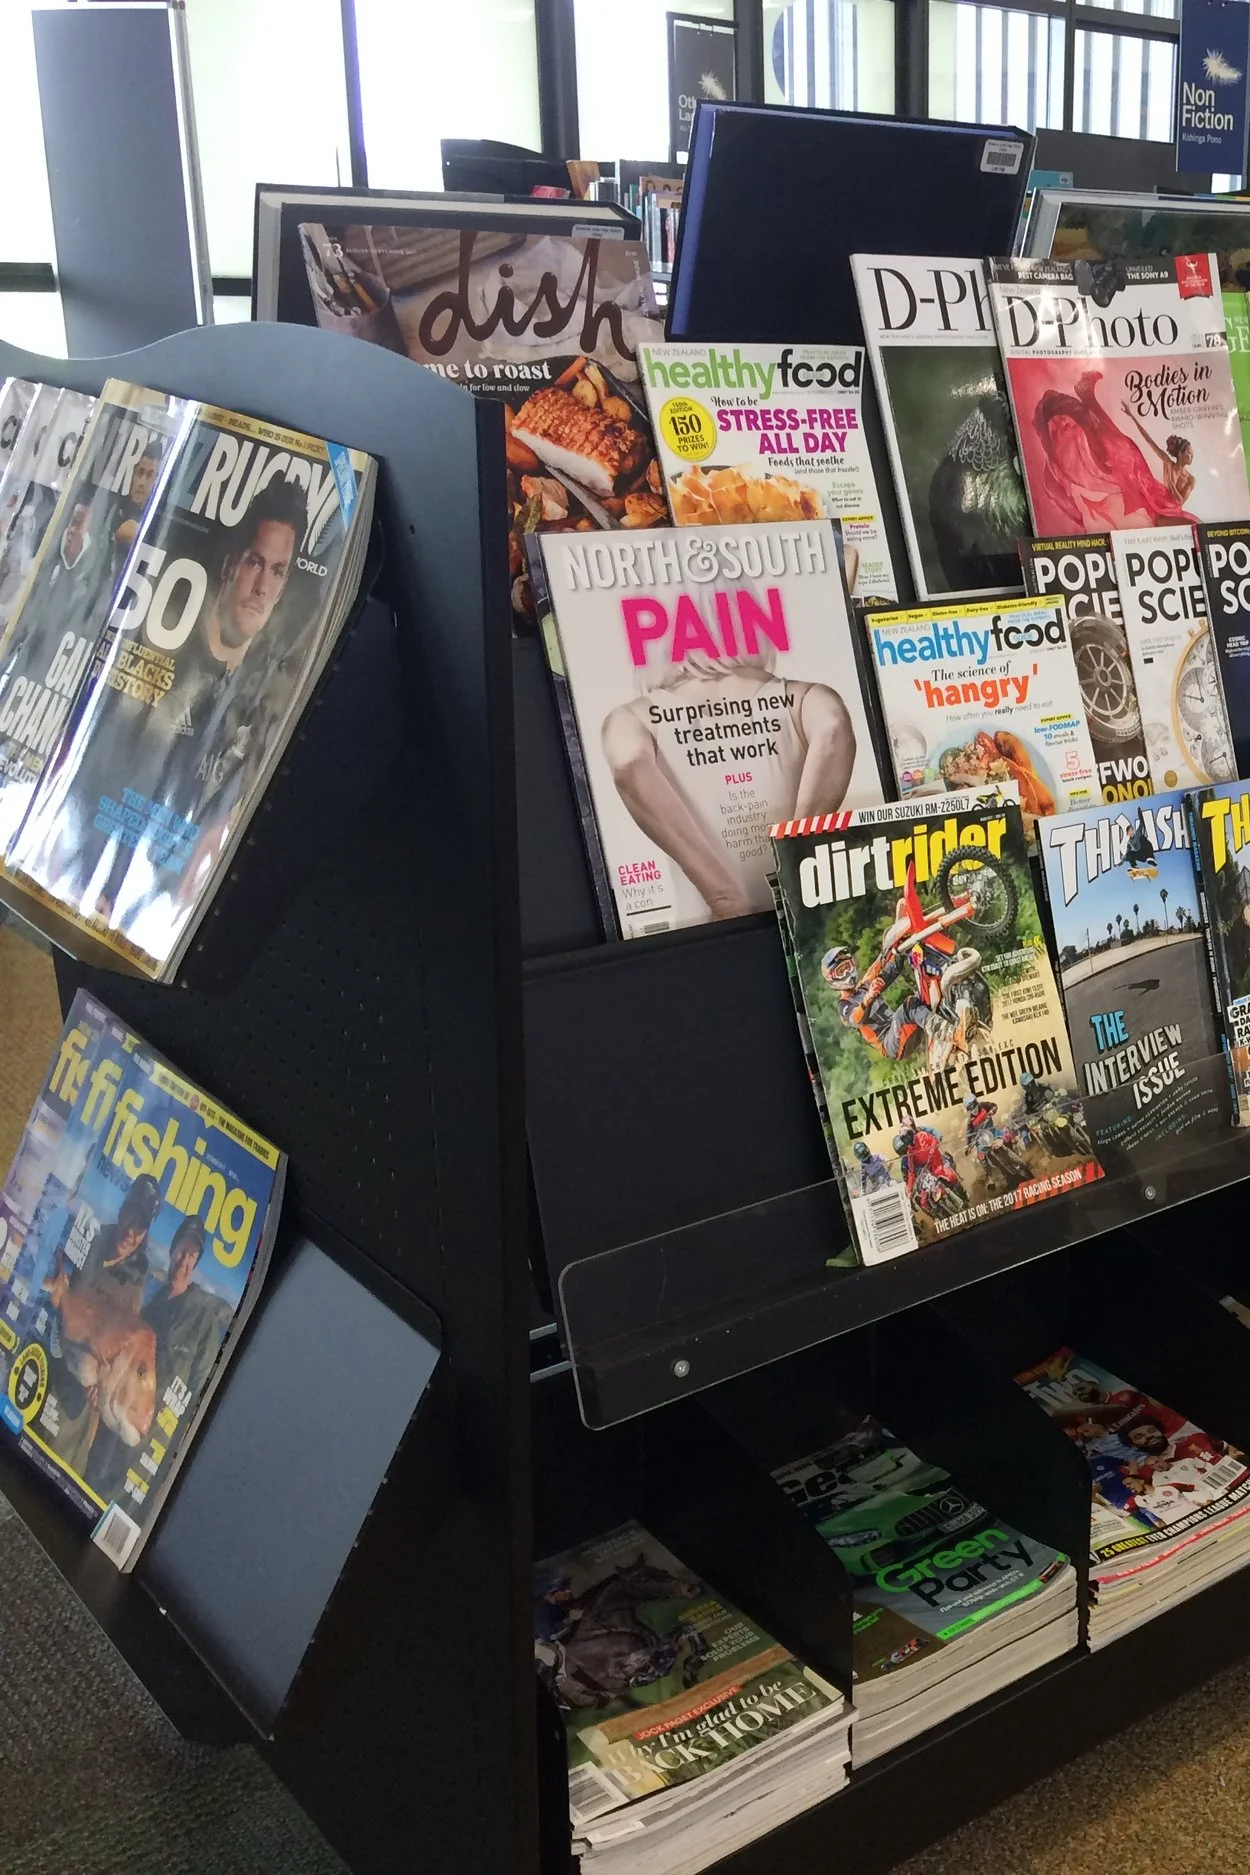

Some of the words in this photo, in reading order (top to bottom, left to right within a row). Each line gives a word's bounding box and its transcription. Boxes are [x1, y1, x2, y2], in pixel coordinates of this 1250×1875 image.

[1183, 81, 1215, 106] Non
[1182, 105, 1233, 130] Fiction
[1033, 272, 1059, 281] CAMERA
[1060, 272, 1073, 281] BAG
[1127, 272, 1140, 280] THE
[418, 230, 637, 361] dish
[465, 360, 490, 379] to
[494, 360, 552, 380] roast
[1125, 364, 1188, 404] Bodies
[1193, 361, 1212, 380] in
[482, 384, 495, 392] low
[497, 384, 512, 392] and
[514, 384, 530, 392] slow
[711, 396, 735, 407] How
[737, 397, 747, 406] to
[748, 397, 758, 406] be
[1137, 386, 1210, 418] Motion
[669, 413, 702, 436] 150
[717, 408, 859, 431] STRESS-FREE
[677, 443, 689, 453] TO
[678, 435, 705, 445] PRIZES
[759, 433, 800, 455] ALL
[804, 432, 848, 454] DAY
[768, 457, 794, 467] Foods
[795, 457, 816, 467] that
[560, 531, 827, 592] NORTH&SOUTH
[110, 542, 208, 650] 50
[620, 586, 792, 667] PAIN
[115, 653, 177, 691] BLACKS
[931, 668, 955, 682] The
[957, 666, 996, 678] science
[999, 661, 1012, 676] of
[649, 697, 753, 725] Surprising
[758, 692, 796, 712] new
[994, 706, 1014, 717] really
[674, 716, 782, 746] treatments
[687, 746, 725, 768] that
[729, 738, 780, 762] work
[724, 771, 753, 786] PLUS
[739, 788, 756, 800] the
[719, 798, 768, 816] back-pain
[726, 810, 767, 828] industry
[858, 810, 875, 823] WIN
[877, 808, 894, 821] OUR
[895, 805, 924, 820] SUZUKI
[721, 823, 749, 840] doing
[739, 846, 769, 862] good?
[617, 860, 656, 877] CLEAN
[620, 870, 662, 886] EATING
[1090, 1009, 1129, 1050] THE
[1084, 1023, 1183, 1097] INTERVIEW
[841, 1062, 964, 1141] EXTREME
[965, 1036, 1064, 1099] EDITION
[1133, 1052, 1186, 1110] ISSUE
[104, 1088, 258, 1269] fishing
[934, 1218, 950, 1235] THE
[950, 1213, 968, 1231] HEAT
[968, 1208, 977, 1223] IS
[989, 1199, 1003, 1216] THE
[1004, 1191, 1022, 1210] 2017
[1022, 1181, 1051, 1202] RACING
[1050, 1168, 1083, 1192] SEASON
[1100, 1547, 1113, 1558] 25
[1113, 1538, 1148, 1554] GREATEST
[1163, 1511, 1208, 1537] CHAMPIONS
[1206, 1498, 1233, 1516] LEAGUE
[875, 1527, 1010, 1593] Green
[636, 1722, 665, 1741] JOCK
[665, 1709, 696, 1731] PAGET
[695, 1686, 741, 1716] EXCLUSIVE
[657, 1724, 693, 1748] I'm
[696, 1701, 741, 1735] glad
[741, 1691, 761, 1712] to
[759, 1679, 782, 1700] be
[613, 1739, 711, 1788] BACK
[709, 1681, 818, 1749] HOME
